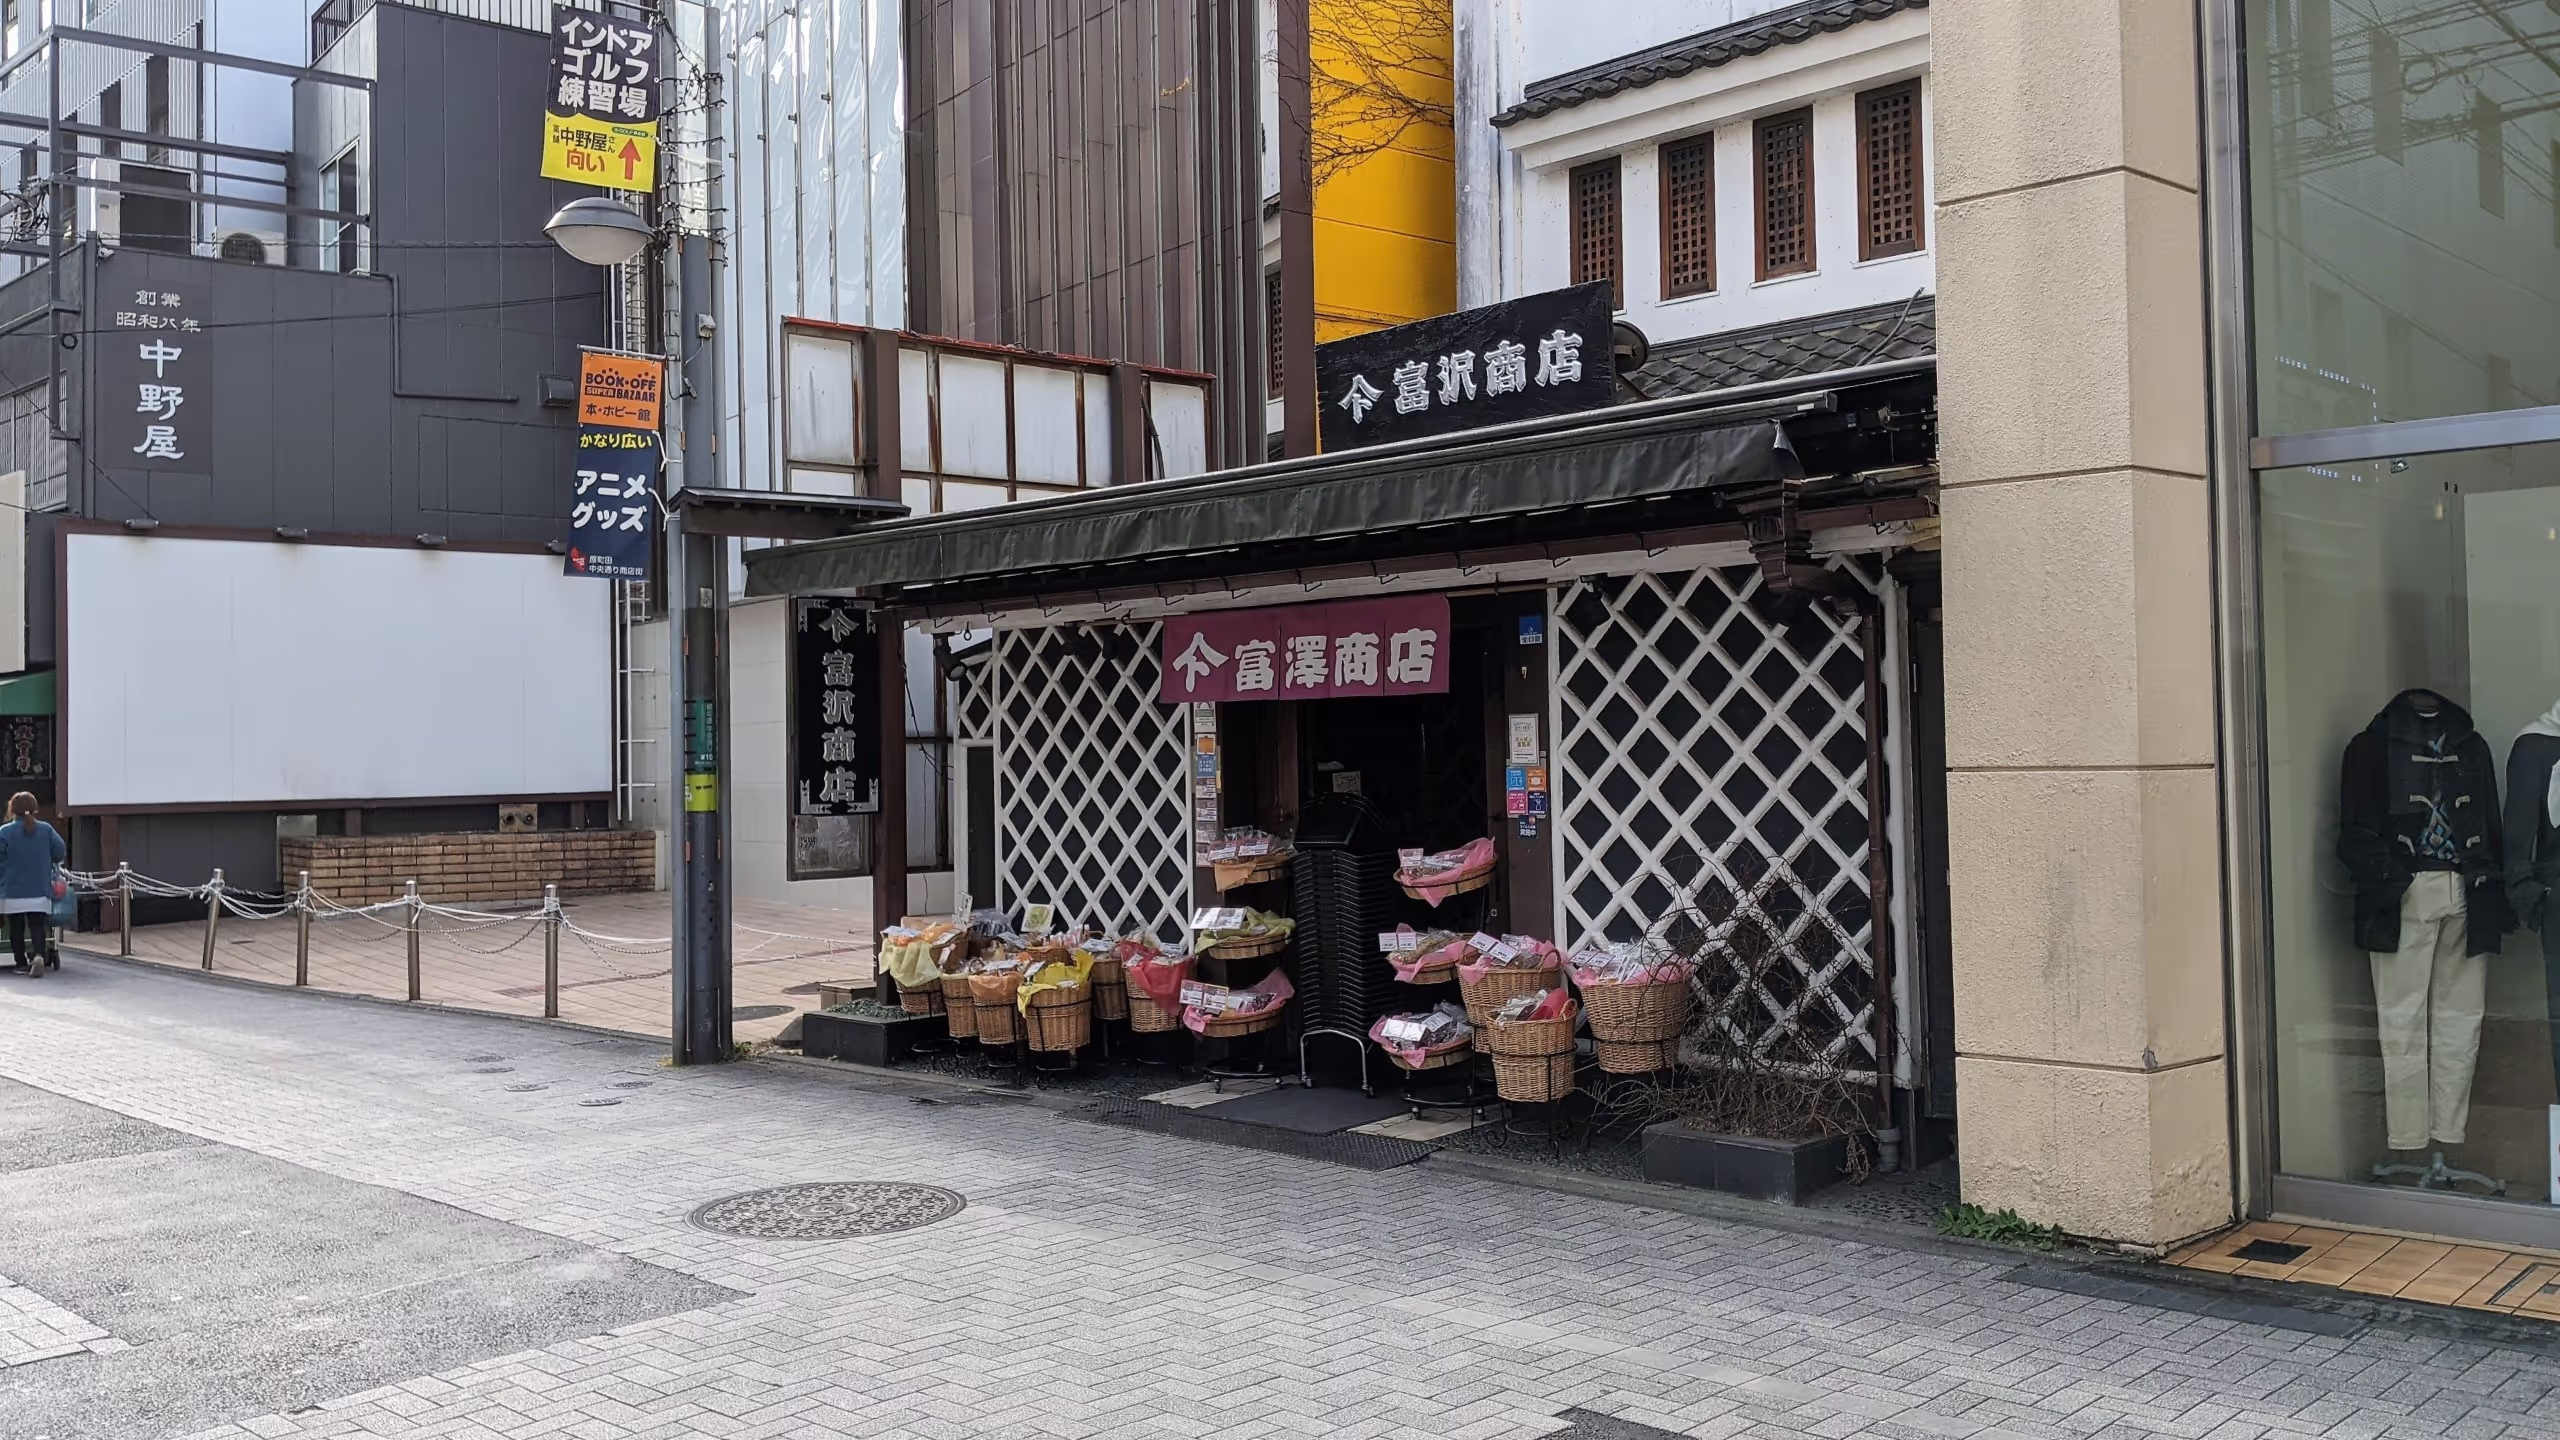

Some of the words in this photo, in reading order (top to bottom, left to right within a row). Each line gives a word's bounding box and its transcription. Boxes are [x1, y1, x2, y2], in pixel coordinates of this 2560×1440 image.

[560, 16, 653, 57] インドア
[561, 46, 650, 86] ゴルフ
[557, 75, 648, 119] 練習場
[566, 147, 605, 172] 向い
[135, 289, 181, 308] 創業
[116, 311, 202, 334] 昭和八年
[133, 338, 185, 460] 中野屋
[586, 386, 614, 397] SUPER
[616, 388, 656, 403] BAZAAR
[585, 402, 651, 421] 本・ホビー館
[579, 432, 652, 449] かなり広い
[576, 469, 648, 499] アニメ
[571, 501, 648, 532] グッズ
[588, 554, 613, 565] 原町田
[588, 565, 643, 576] 中央通り商店街
